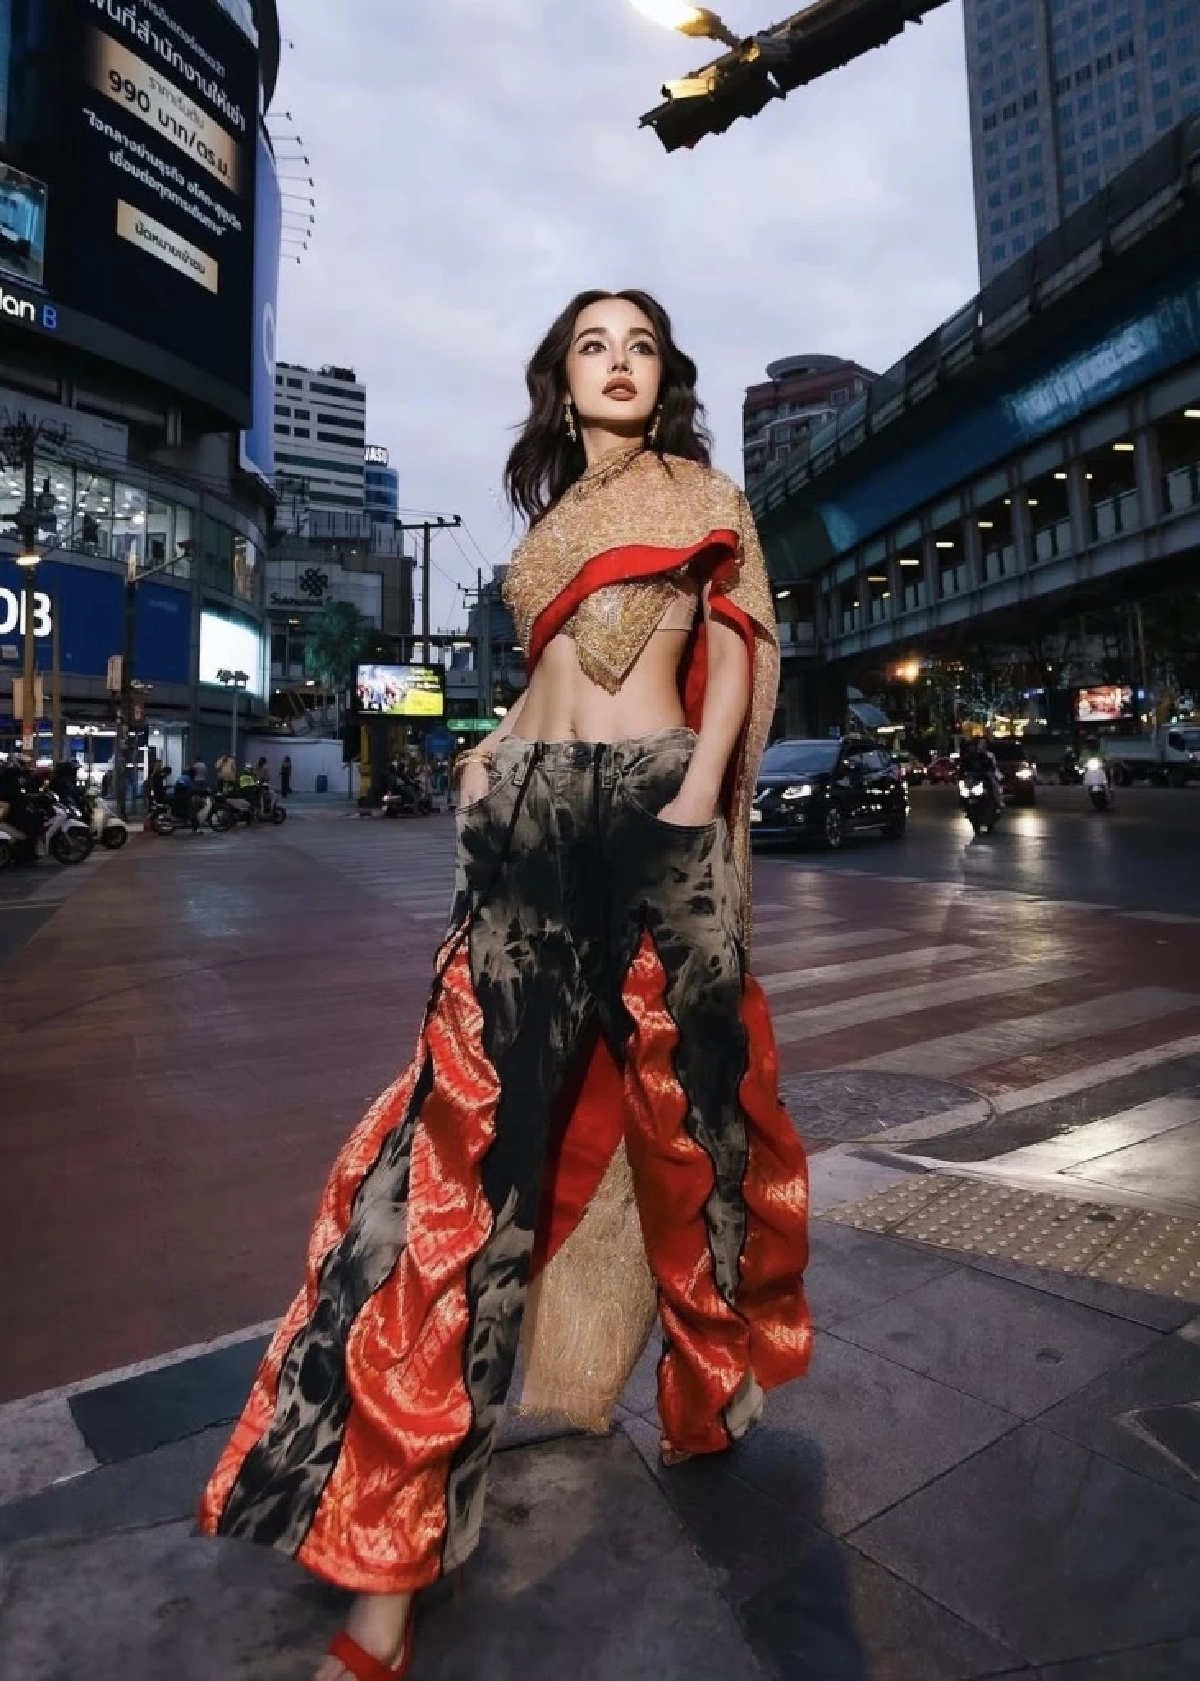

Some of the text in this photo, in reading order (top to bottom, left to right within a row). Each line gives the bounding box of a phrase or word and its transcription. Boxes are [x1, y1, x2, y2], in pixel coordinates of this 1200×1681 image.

[108, 69, 231, 180] 990 บาท/ตร.ม.
[43, 304, 57, 328] B
